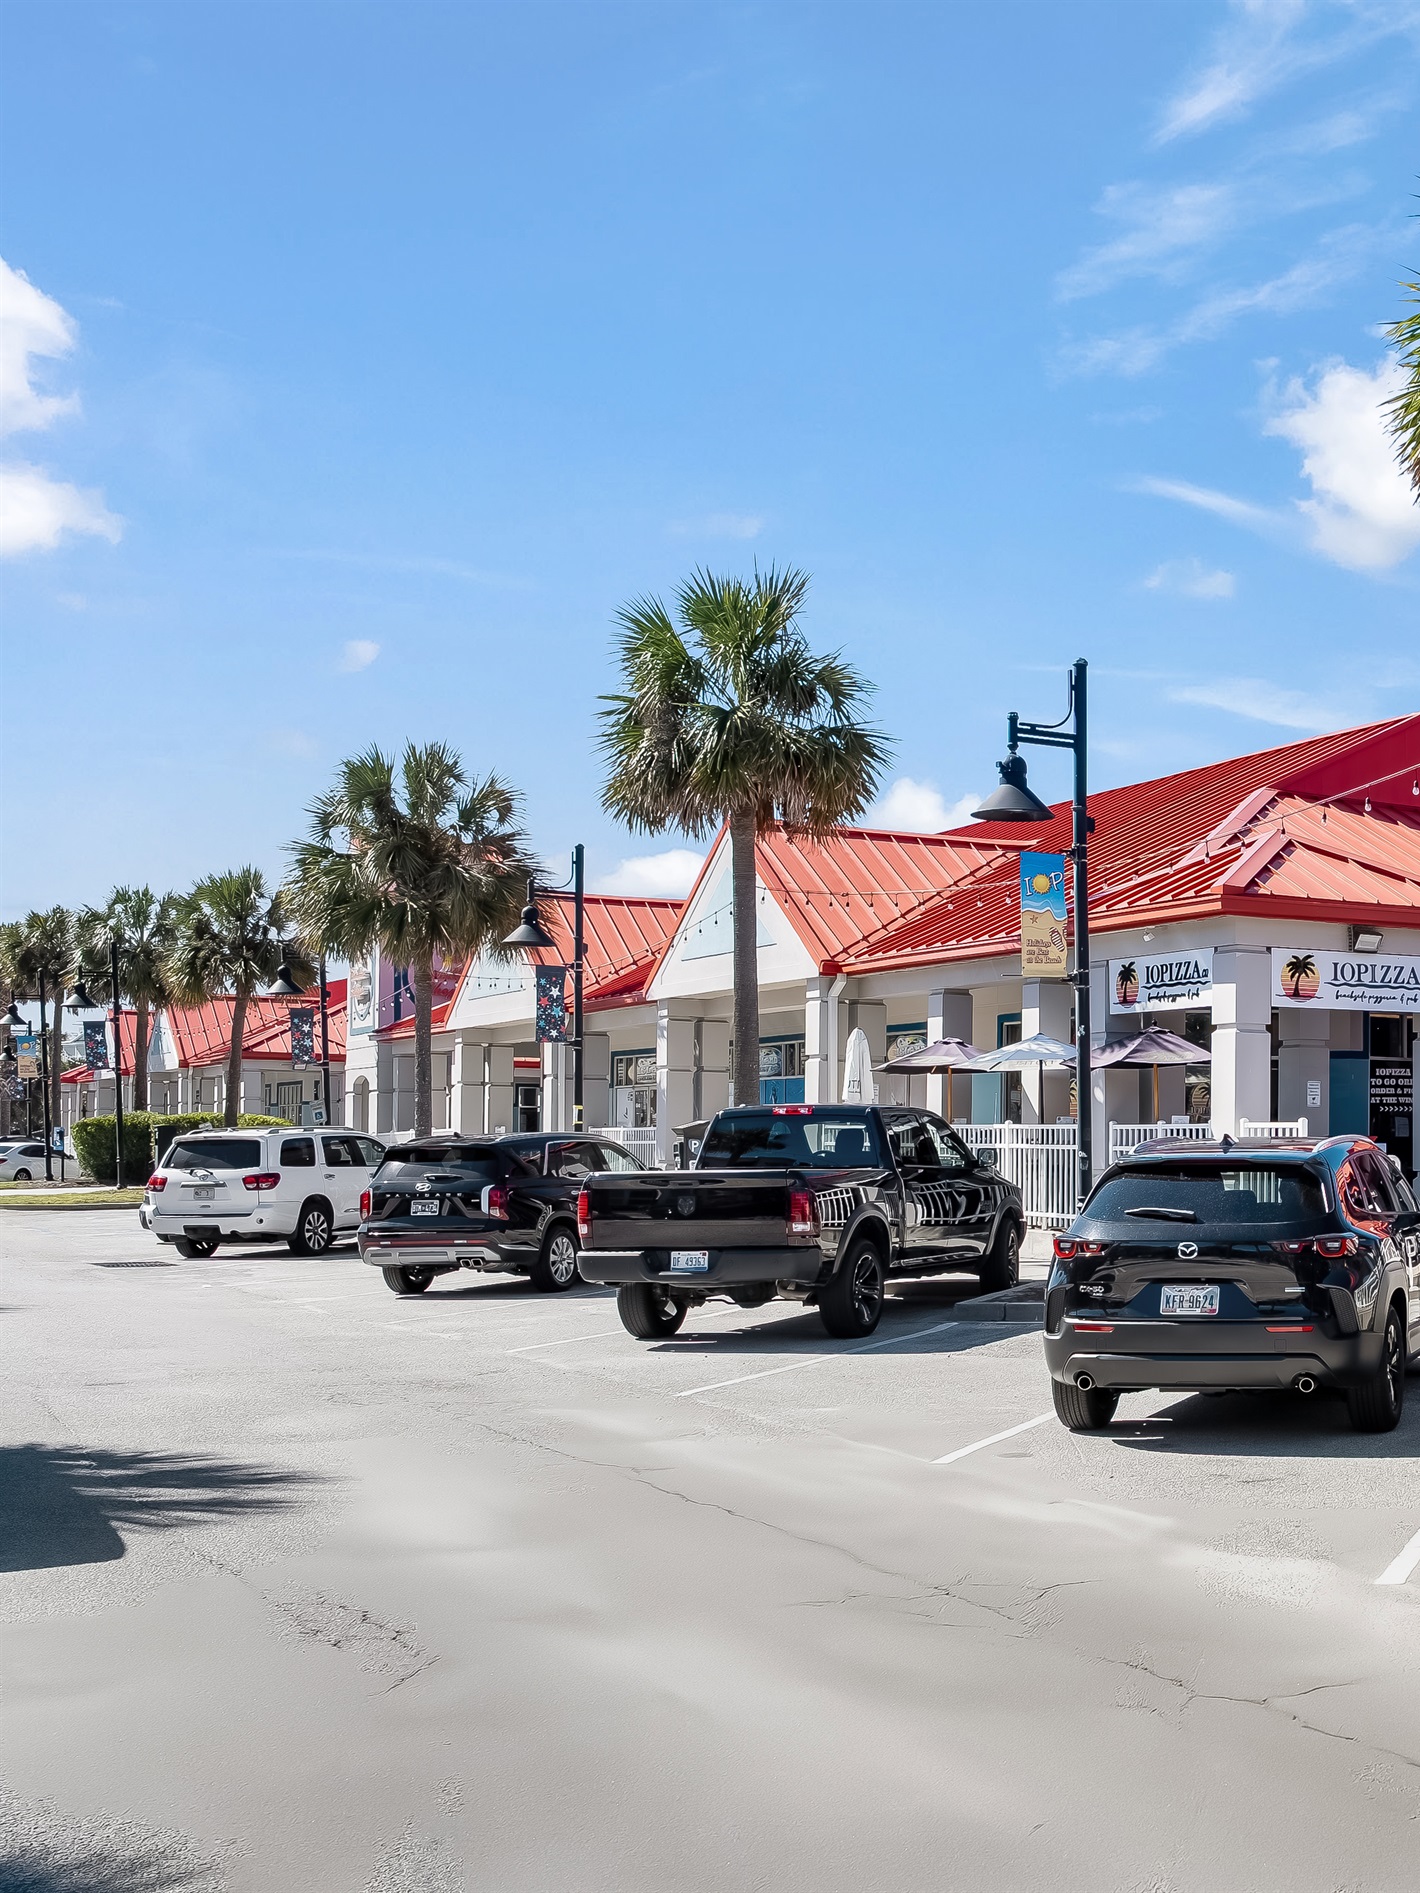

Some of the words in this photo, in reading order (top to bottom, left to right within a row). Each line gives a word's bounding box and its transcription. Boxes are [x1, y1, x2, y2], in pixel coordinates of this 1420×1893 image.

[1145, 960, 1200, 985] IOPIZZA
[1376, 1068, 1411, 1076] IOPIZZA
[692, 1140, 699, 1153] P
